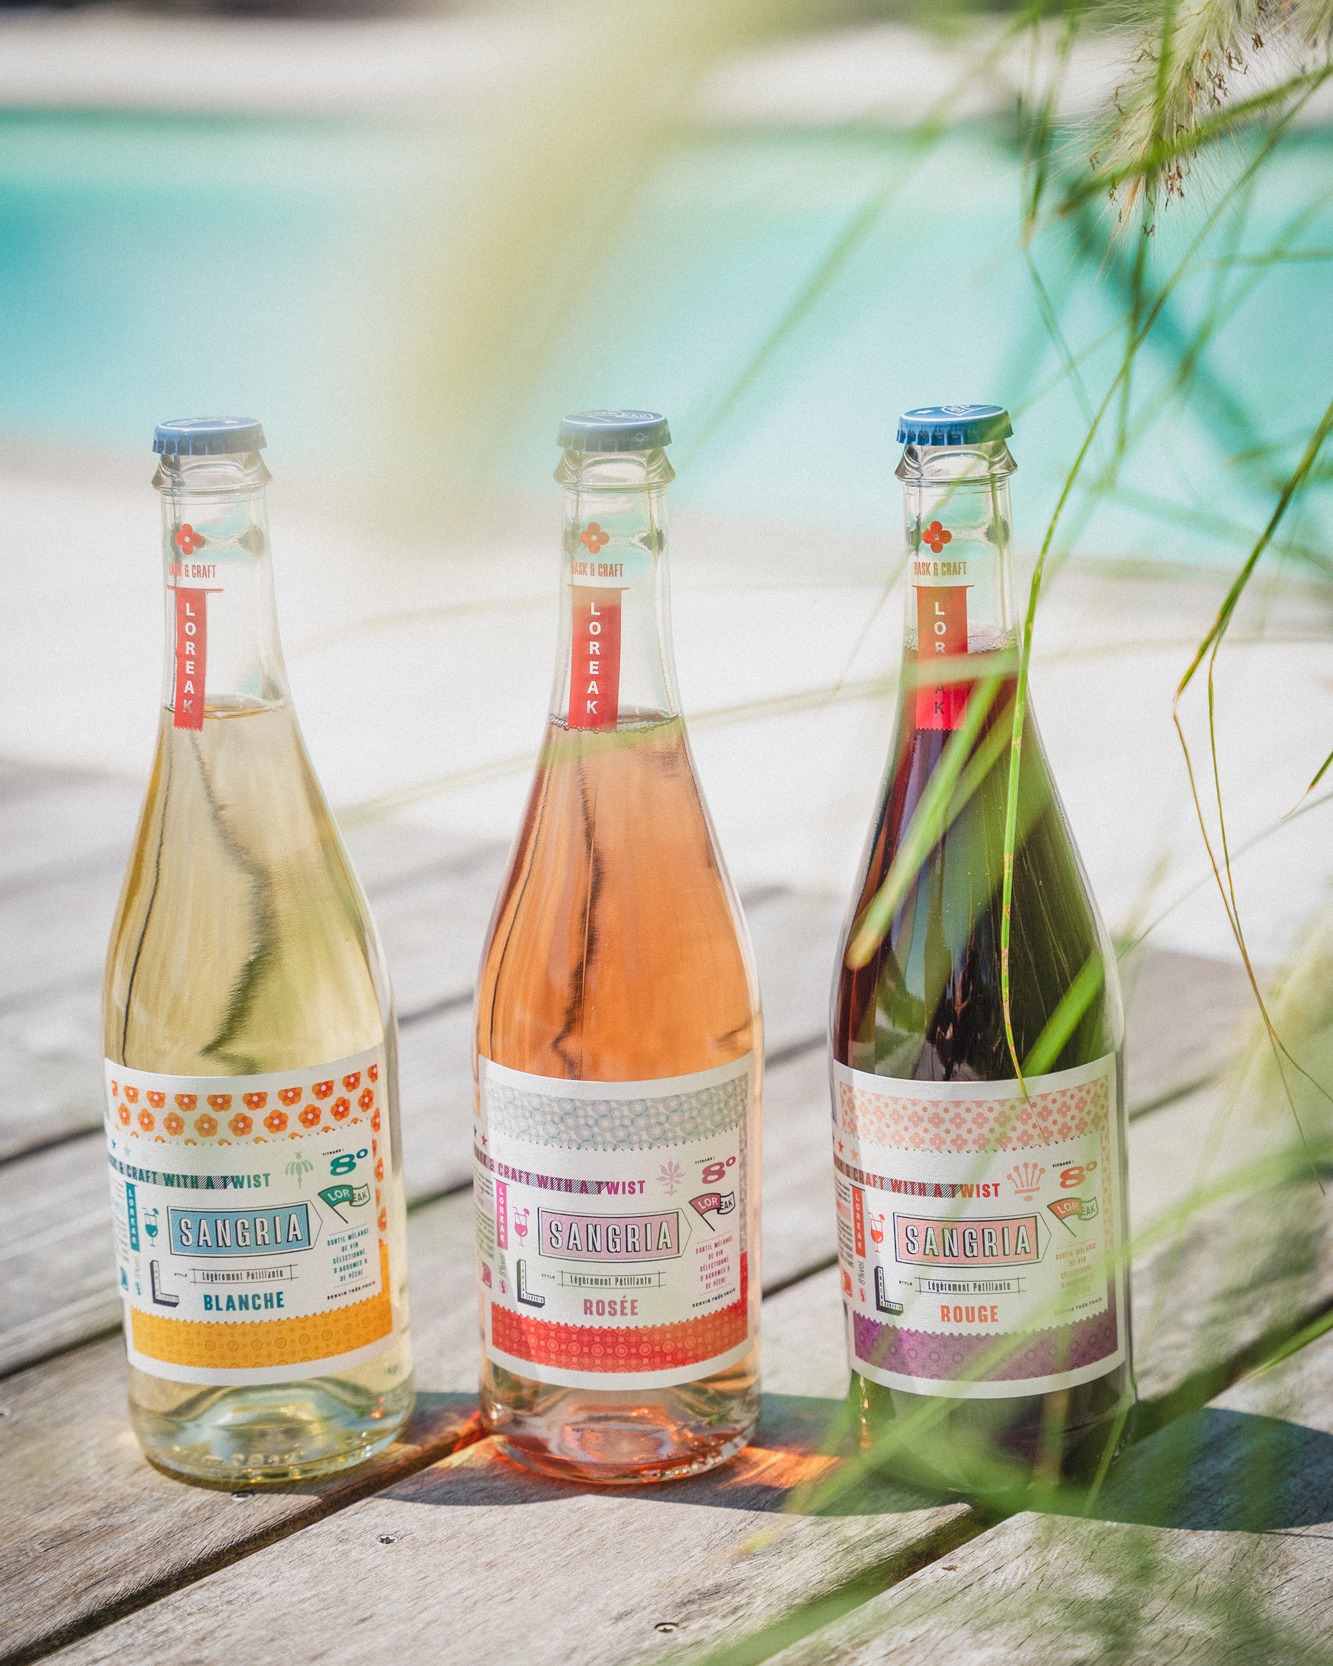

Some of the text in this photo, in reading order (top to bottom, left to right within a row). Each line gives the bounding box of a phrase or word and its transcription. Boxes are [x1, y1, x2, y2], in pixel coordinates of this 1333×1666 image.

[191, 564, 217, 579] CRAFT
[598, 563, 624, 578] CRAFT
[913, 561, 931, 576] BASK
[941, 561, 967, 576] CRAFT
[182, 602, 198, 714] LOREAK
[585, 601, 602, 715] LOREAK
[933, 601, 948, 715] LORAK
[126, 1164, 158, 1185] CRAFT
[163, 1172, 200, 1190] WITH
[204, 1175, 215, 1190] A
[220, 1173, 271, 1190] TWIST
[498, 1162, 531, 1185] CRAFT
[536, 1174, 573, 1192] WITH
[579, 1180, 589, 1194] A
[594, 1180, 646, 1195] TWIST
[853, 1167, 885, 1190] CRAFT
[889, 1178, 927, 1197] WITH
[932, 1183, 943, 1198] A
[949, 1183, 1000, 1199] TWIST
[180, 1212, 303, 1248] SANGRIA
[498, 1187, 507, 1244] LOREAK
[854, 1193, 863, 1250] LOREAK
[549, 1219, 673, 1254] SANGRIA
[905, 1224, 1032, 1259] SANGRIA
[202, 1271, 243, 1283] Légèrement
[246, 1269, 284, 1280] Pétillante
[570, 1275, 611, 1286] Légèrement
[615, 1276, 652, 1286] Pétillante
[927, 1281, 970, 1292] Légèrement
[973, 1281, 1011, 1292] Pétillante
[203, 1291, 285, 1312] BLANCHE
[583, 1295, 639, 1317] ROSÉE
[940, 1304, 999, 1324] ROUGE
